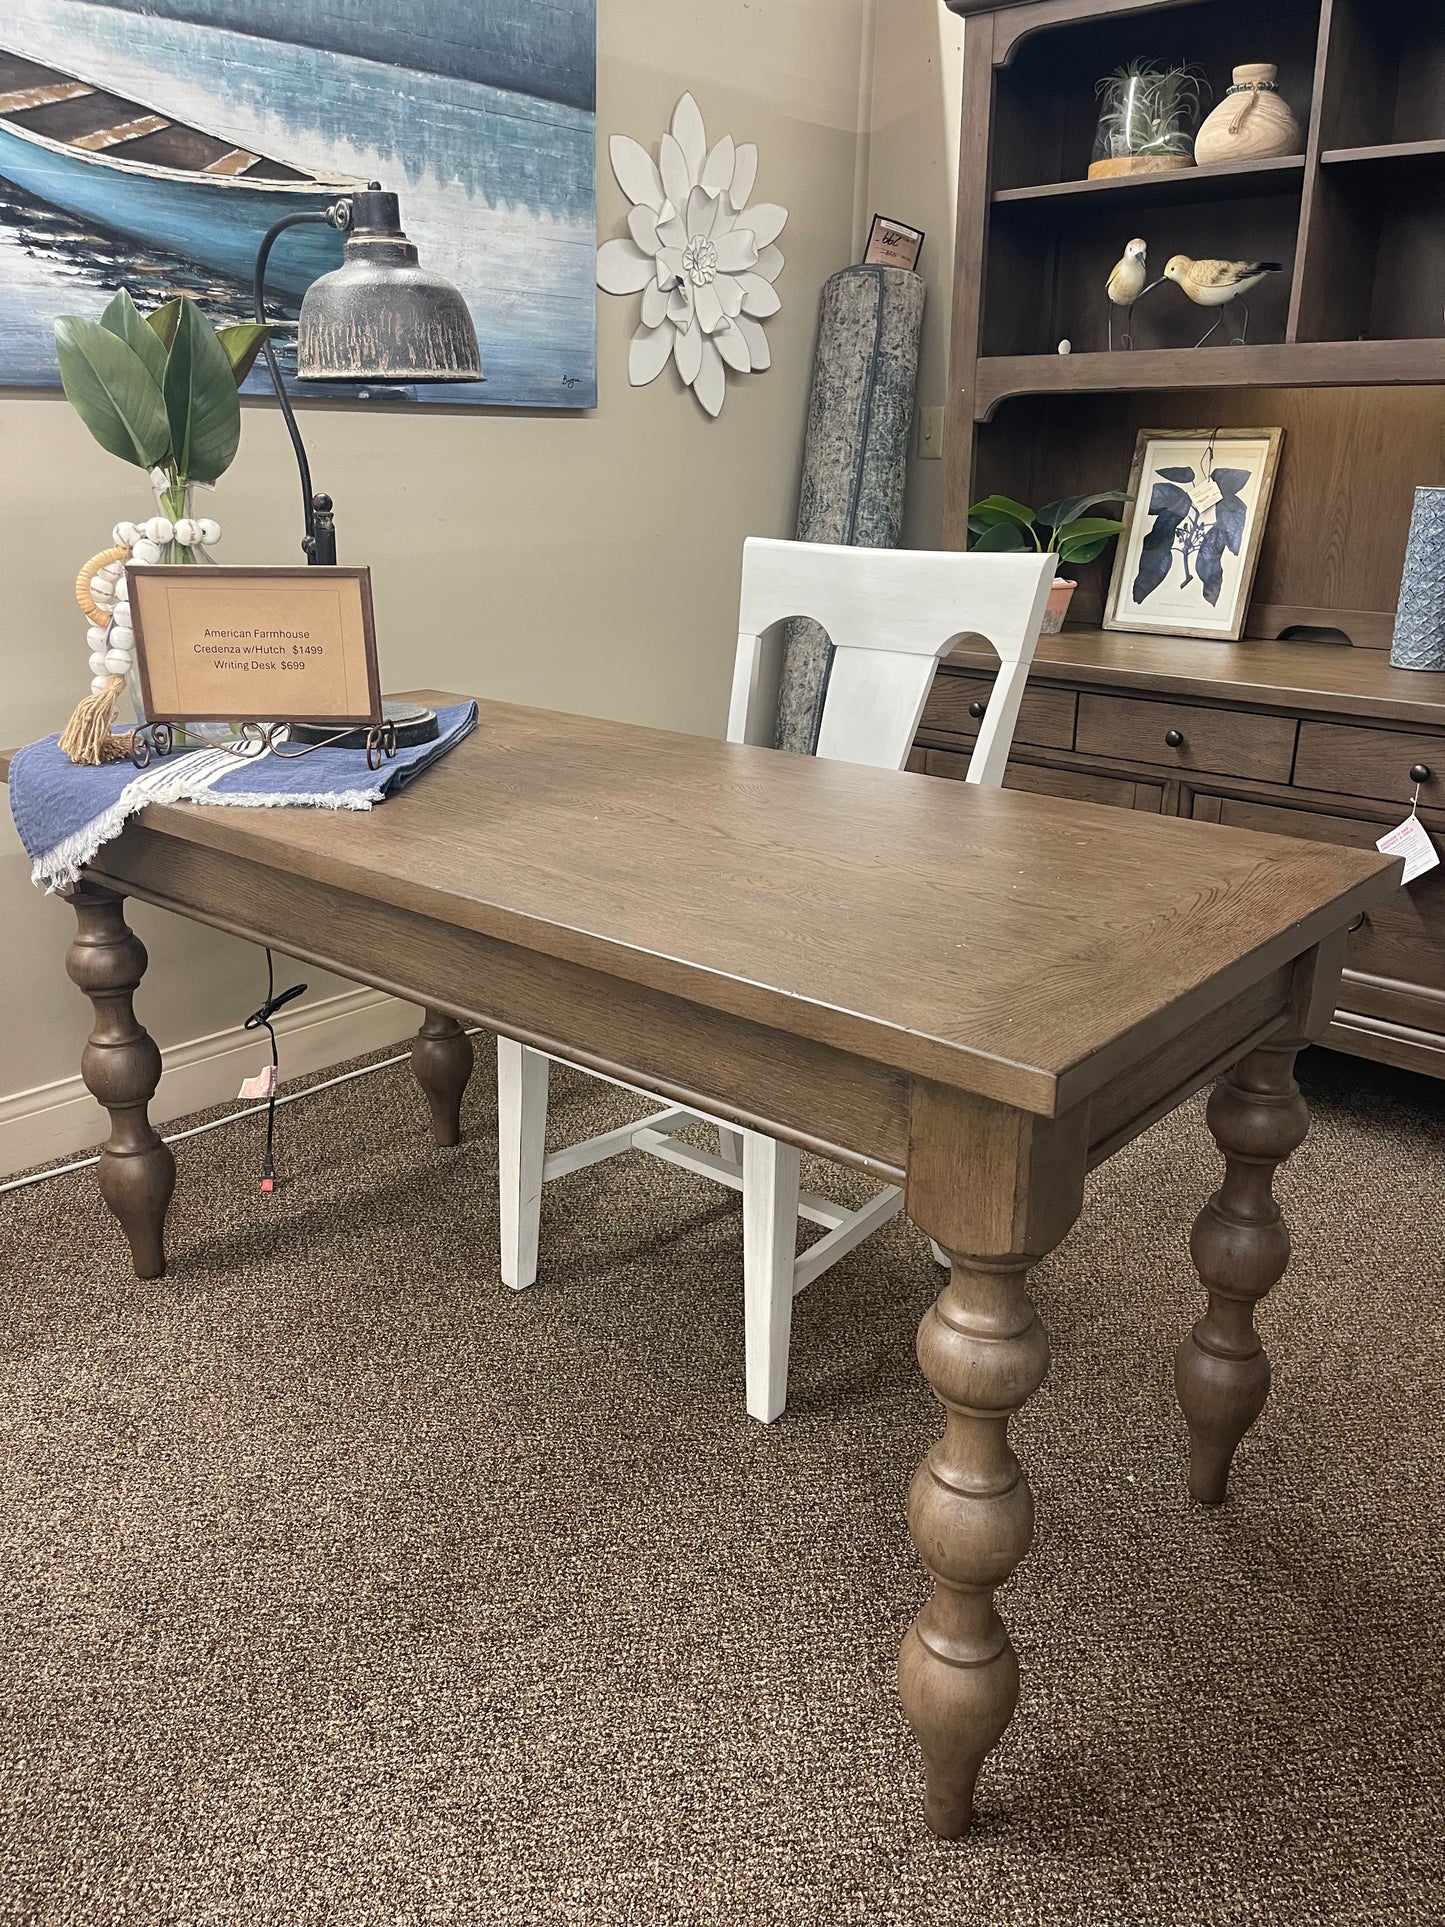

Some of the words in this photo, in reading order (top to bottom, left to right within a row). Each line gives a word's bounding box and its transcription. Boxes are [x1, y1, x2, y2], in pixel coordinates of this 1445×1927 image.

[204, 628, 252, 638] American
[253, 629, 310, 639] Farmhouse
[193, 644, 241, 654] Credenza
[242, 645, 286, 655] w/Hutch
[292, 645, 323, 655] $1499
[213, 660, 249, 671] Writing
[251, 660, 277, 670] Desk
[280, 660, 306, 670] $699
